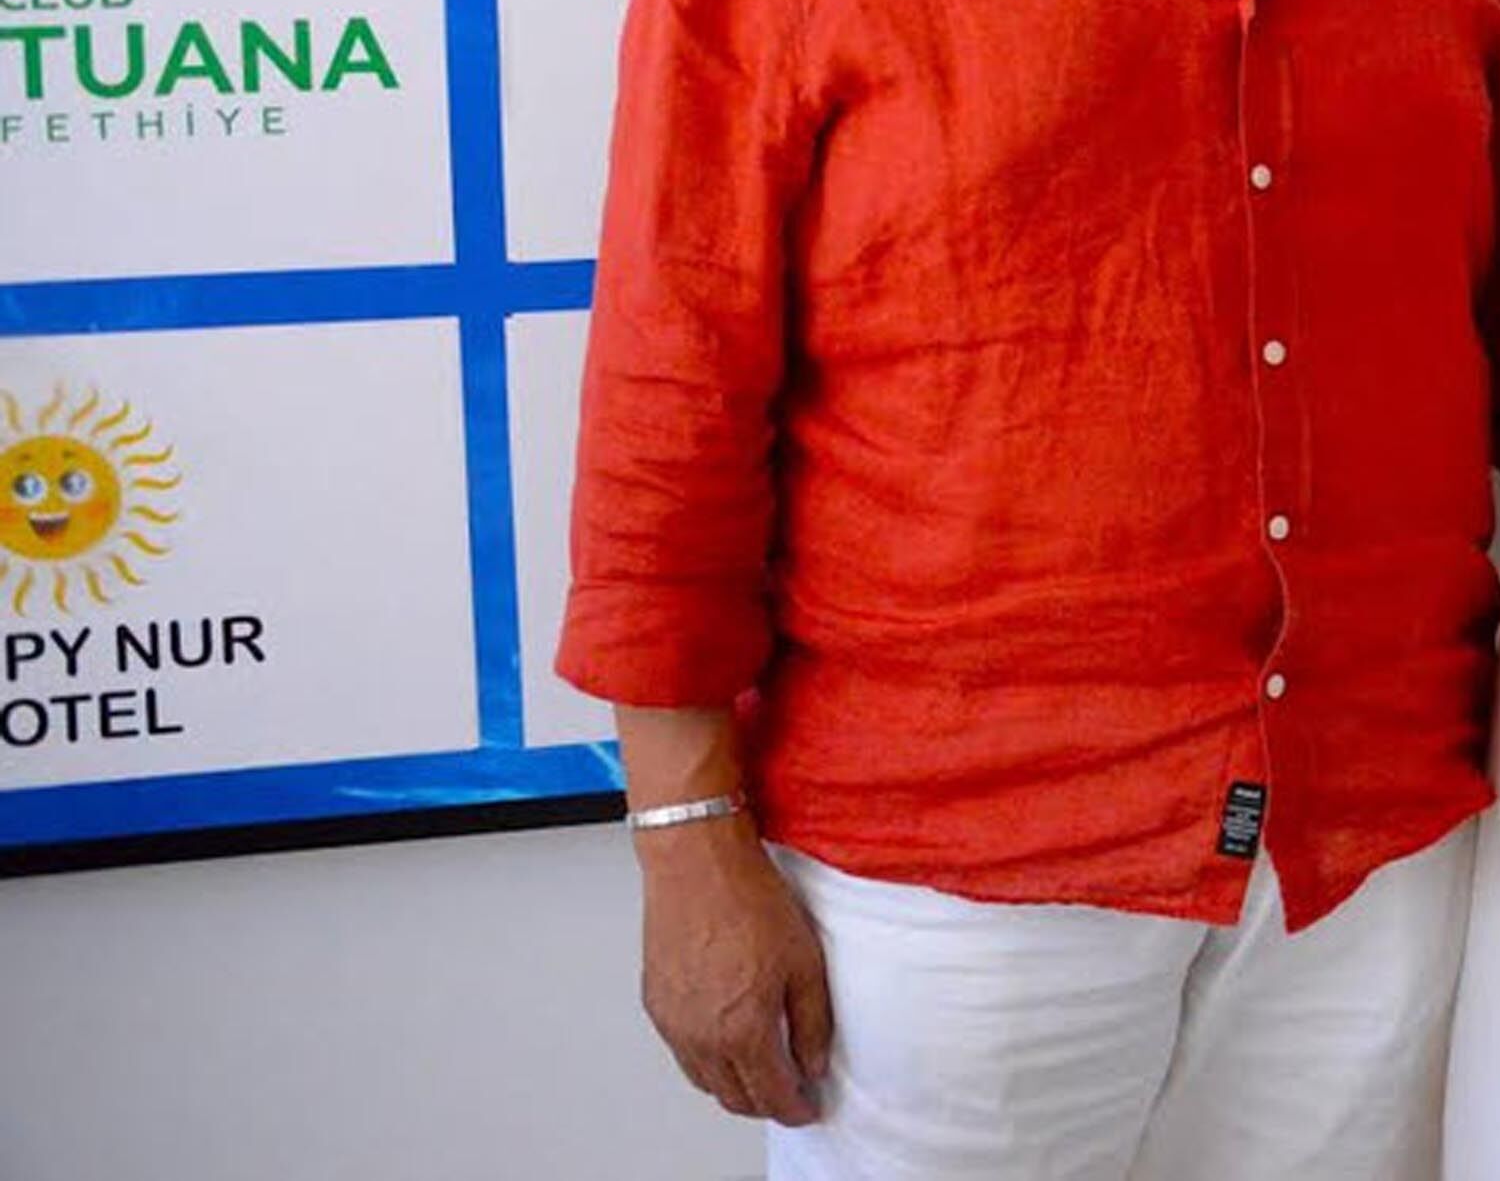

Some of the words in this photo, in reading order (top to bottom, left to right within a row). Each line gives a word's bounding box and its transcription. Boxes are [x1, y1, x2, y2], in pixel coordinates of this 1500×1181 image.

[0, 17, 399, 100] TUANA
[1, 104, 286, 144] FETHİYE
[5, 627, 91, 682] PY
[116, 616, 266, 673] NUR
[0, 687, 184, 748] OTEL
